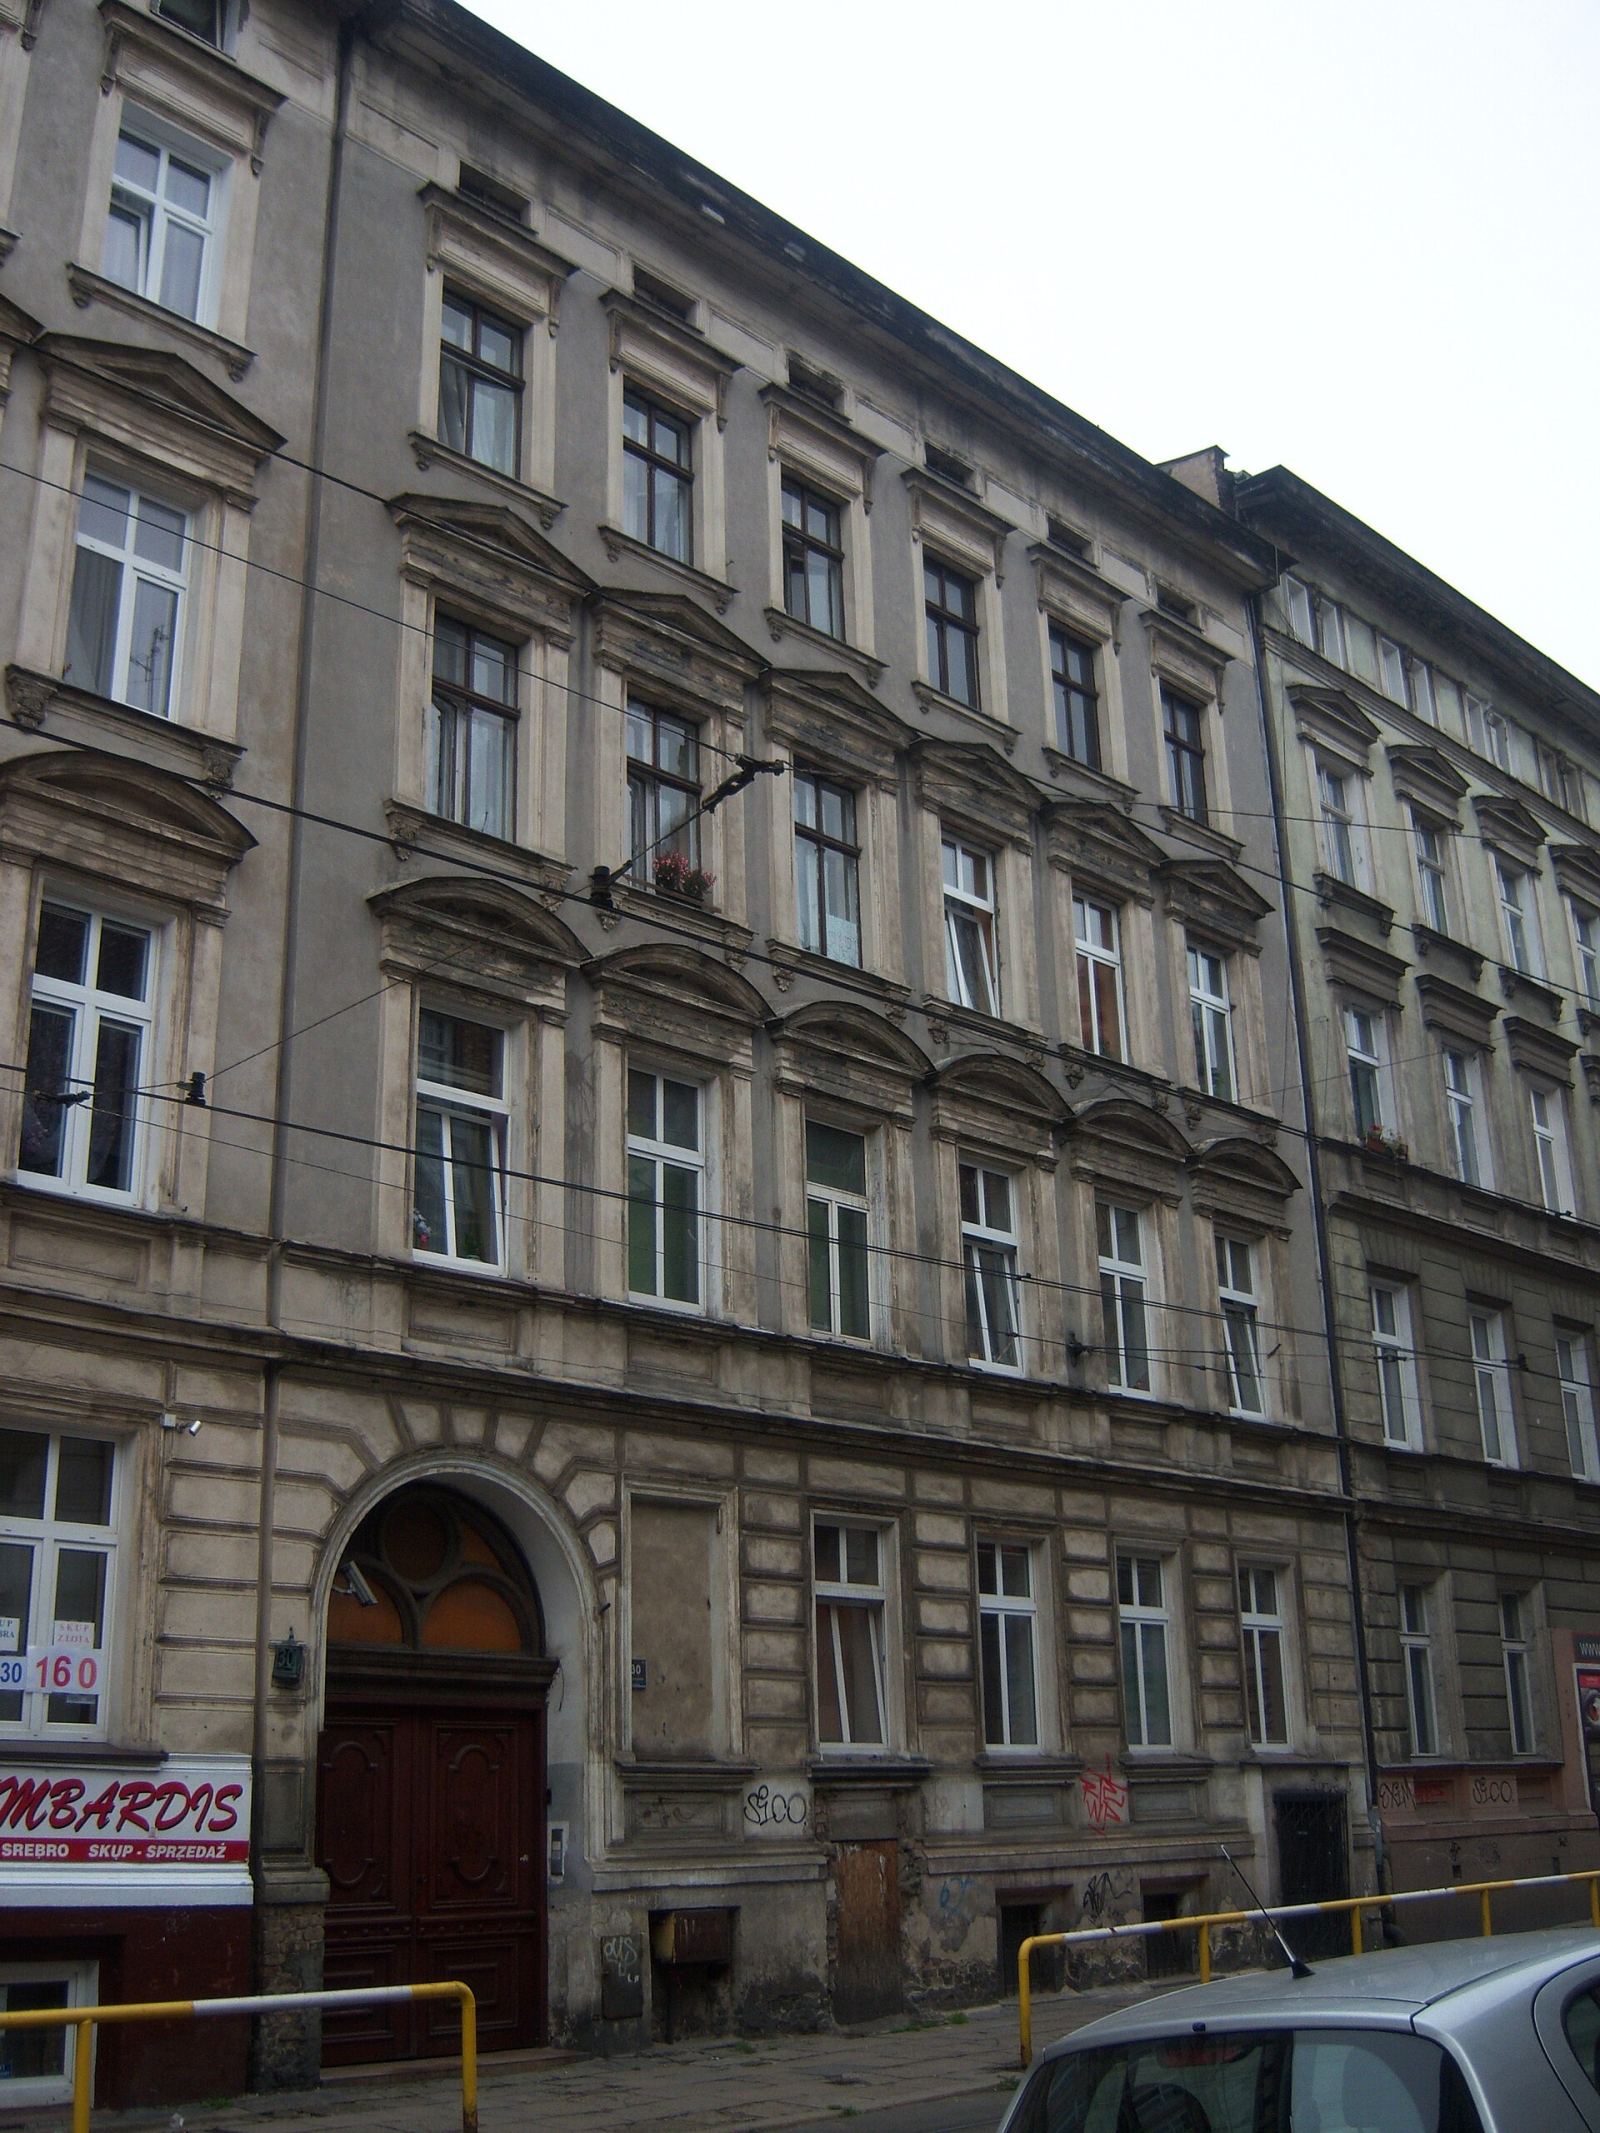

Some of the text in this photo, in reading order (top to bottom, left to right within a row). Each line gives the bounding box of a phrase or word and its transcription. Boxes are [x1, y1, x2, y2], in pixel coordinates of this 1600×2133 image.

[0, 1662, 22, 1683] 30
[36, 1655, 97, 1689] 160
[1, 1843, 70, 1858] SREBRO
[88, 1844, 134, 1858] SKUP
[146, 1843, 227, 1859] SPRZEDAŻ
